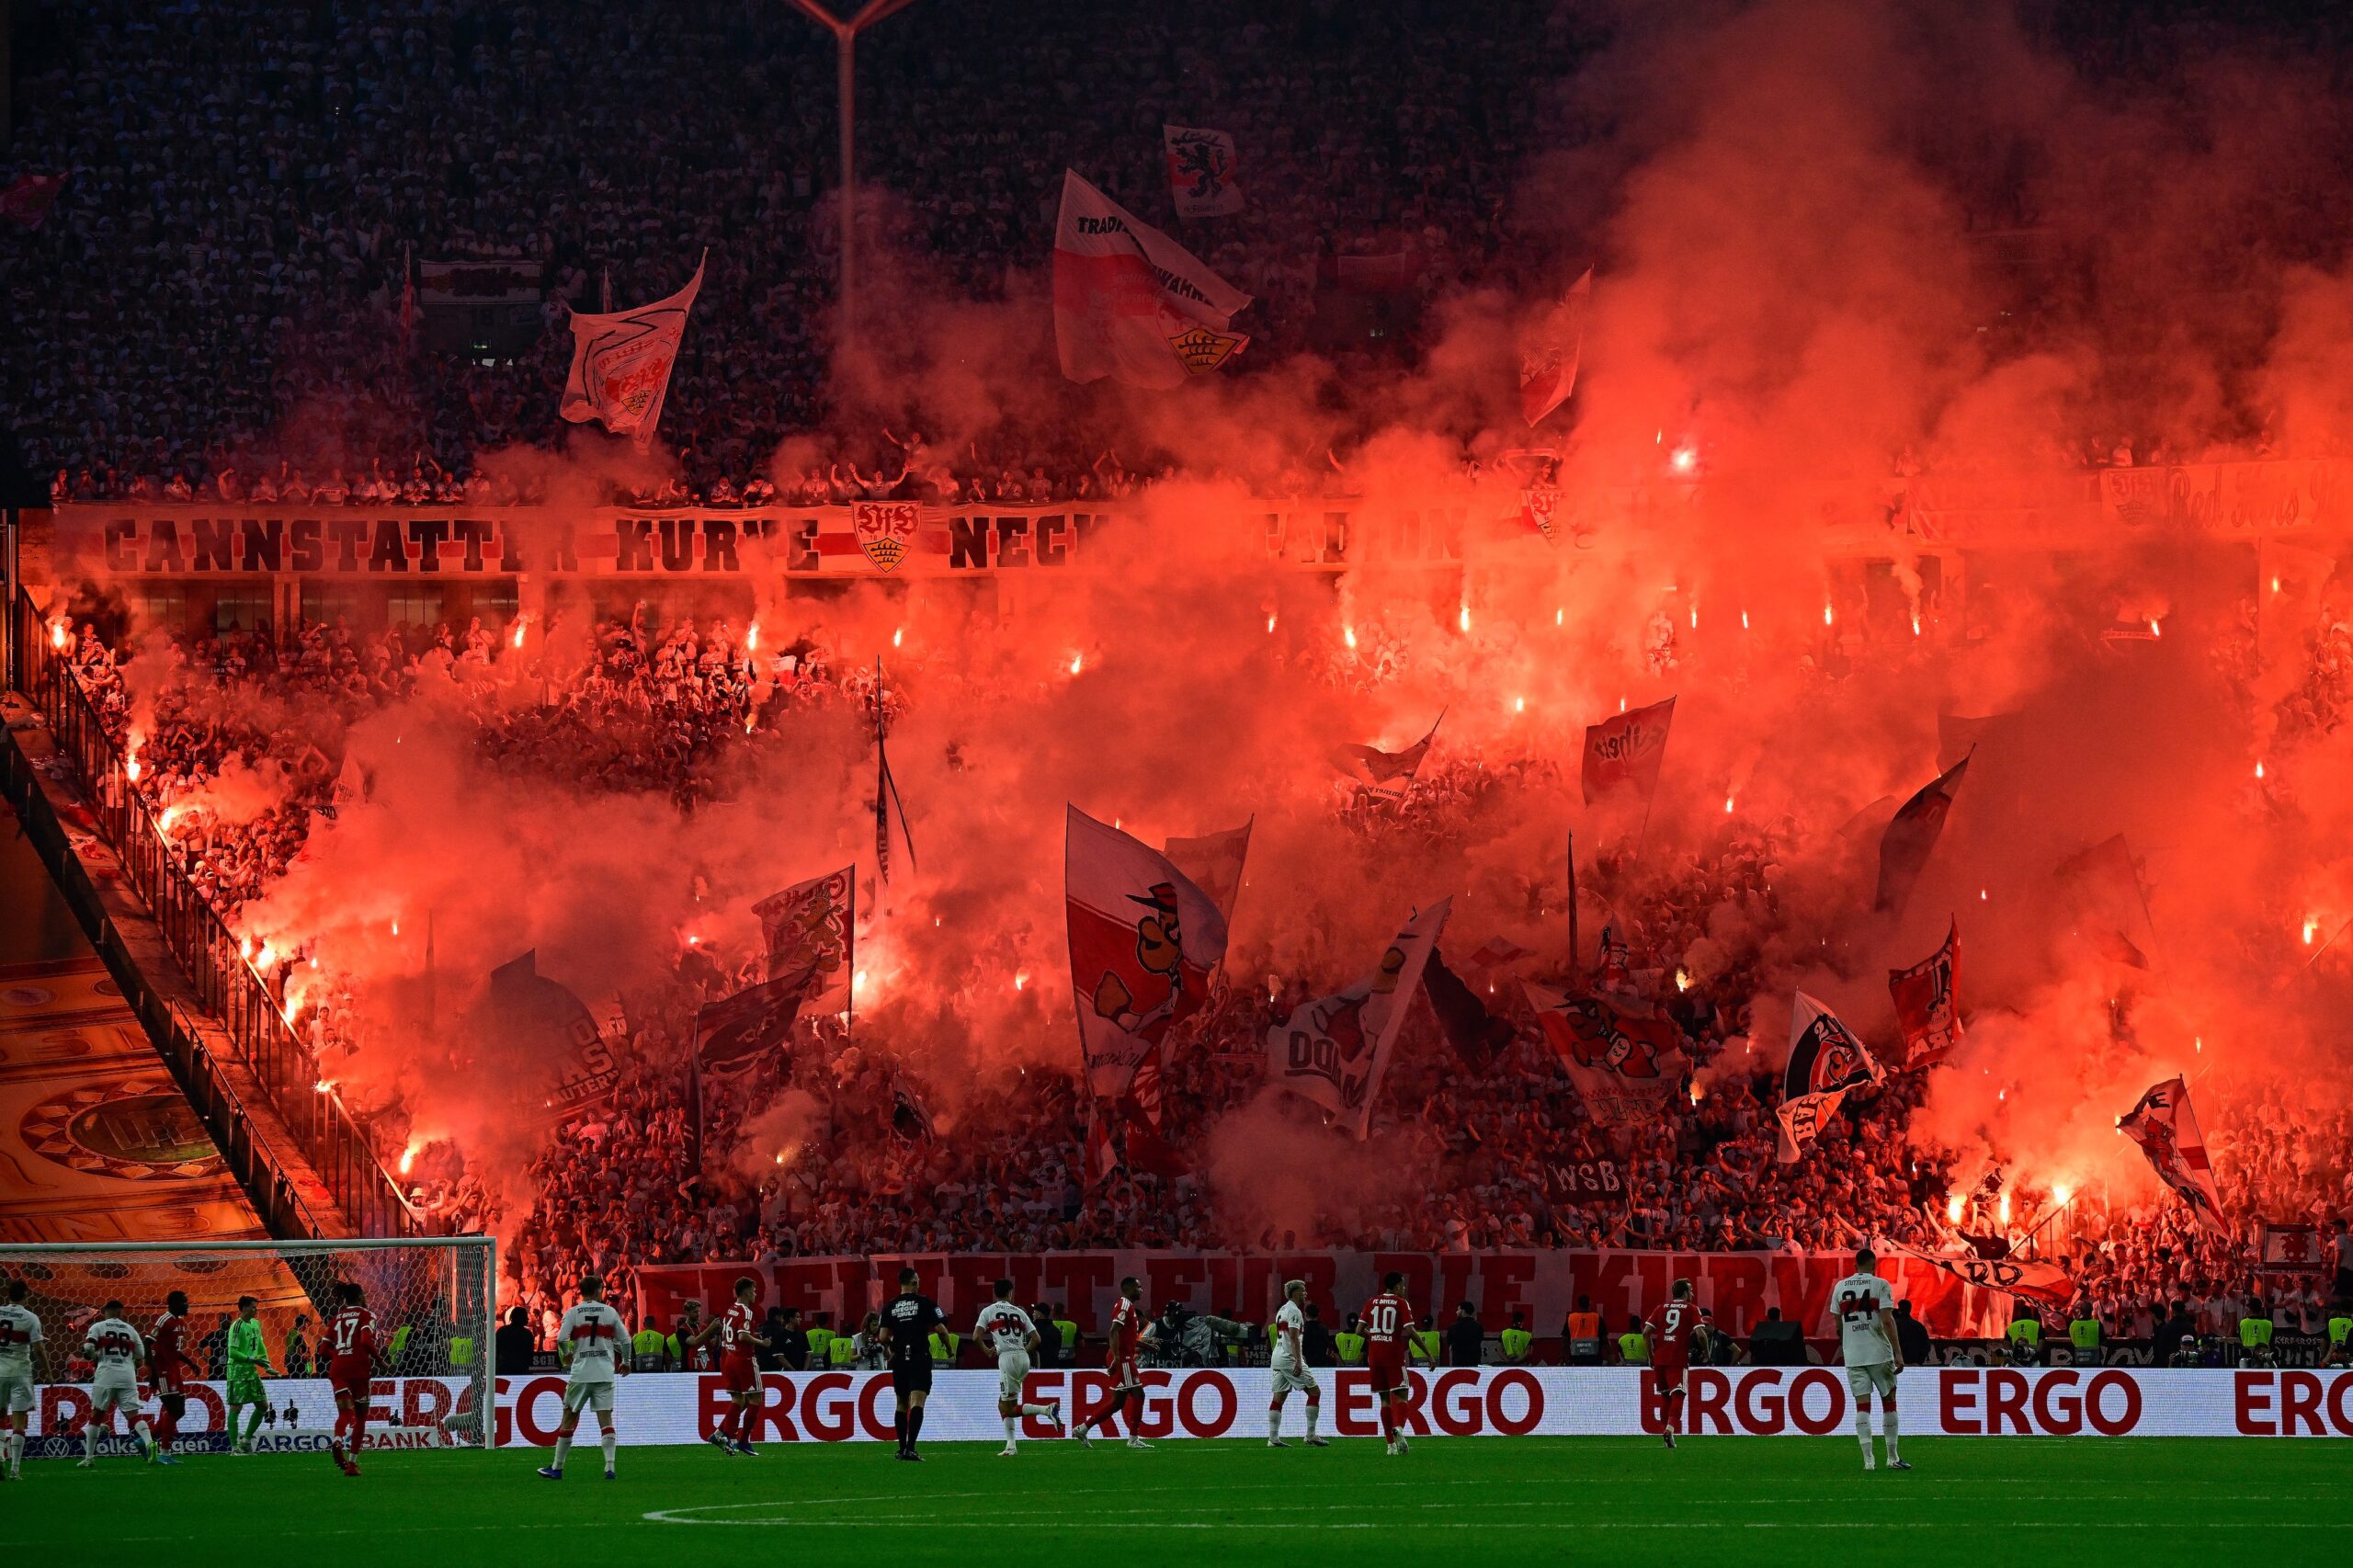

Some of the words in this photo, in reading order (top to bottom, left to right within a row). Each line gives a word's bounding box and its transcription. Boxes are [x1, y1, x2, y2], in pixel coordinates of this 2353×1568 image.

[1548, 1161, 1620, 1192] WSB
[1370, 1305, 1397, 1334] 10
[1665, 1309, 1680, 1334] 9
[1842, 1289, 1873, 1324] 24
[334, 1318, 359, 1350] 17
[585, 1315, 599, 1347] 7
[698, 1371, 906, 1442] ERGO
[1021, 1369, 1238, 1439] ERGO
[1336, 1368, 1544, 1437] ERGO
[1640, 1368, 1846, 1437] ERGO
[1939, 1369, 2143, 1437] ERGO
